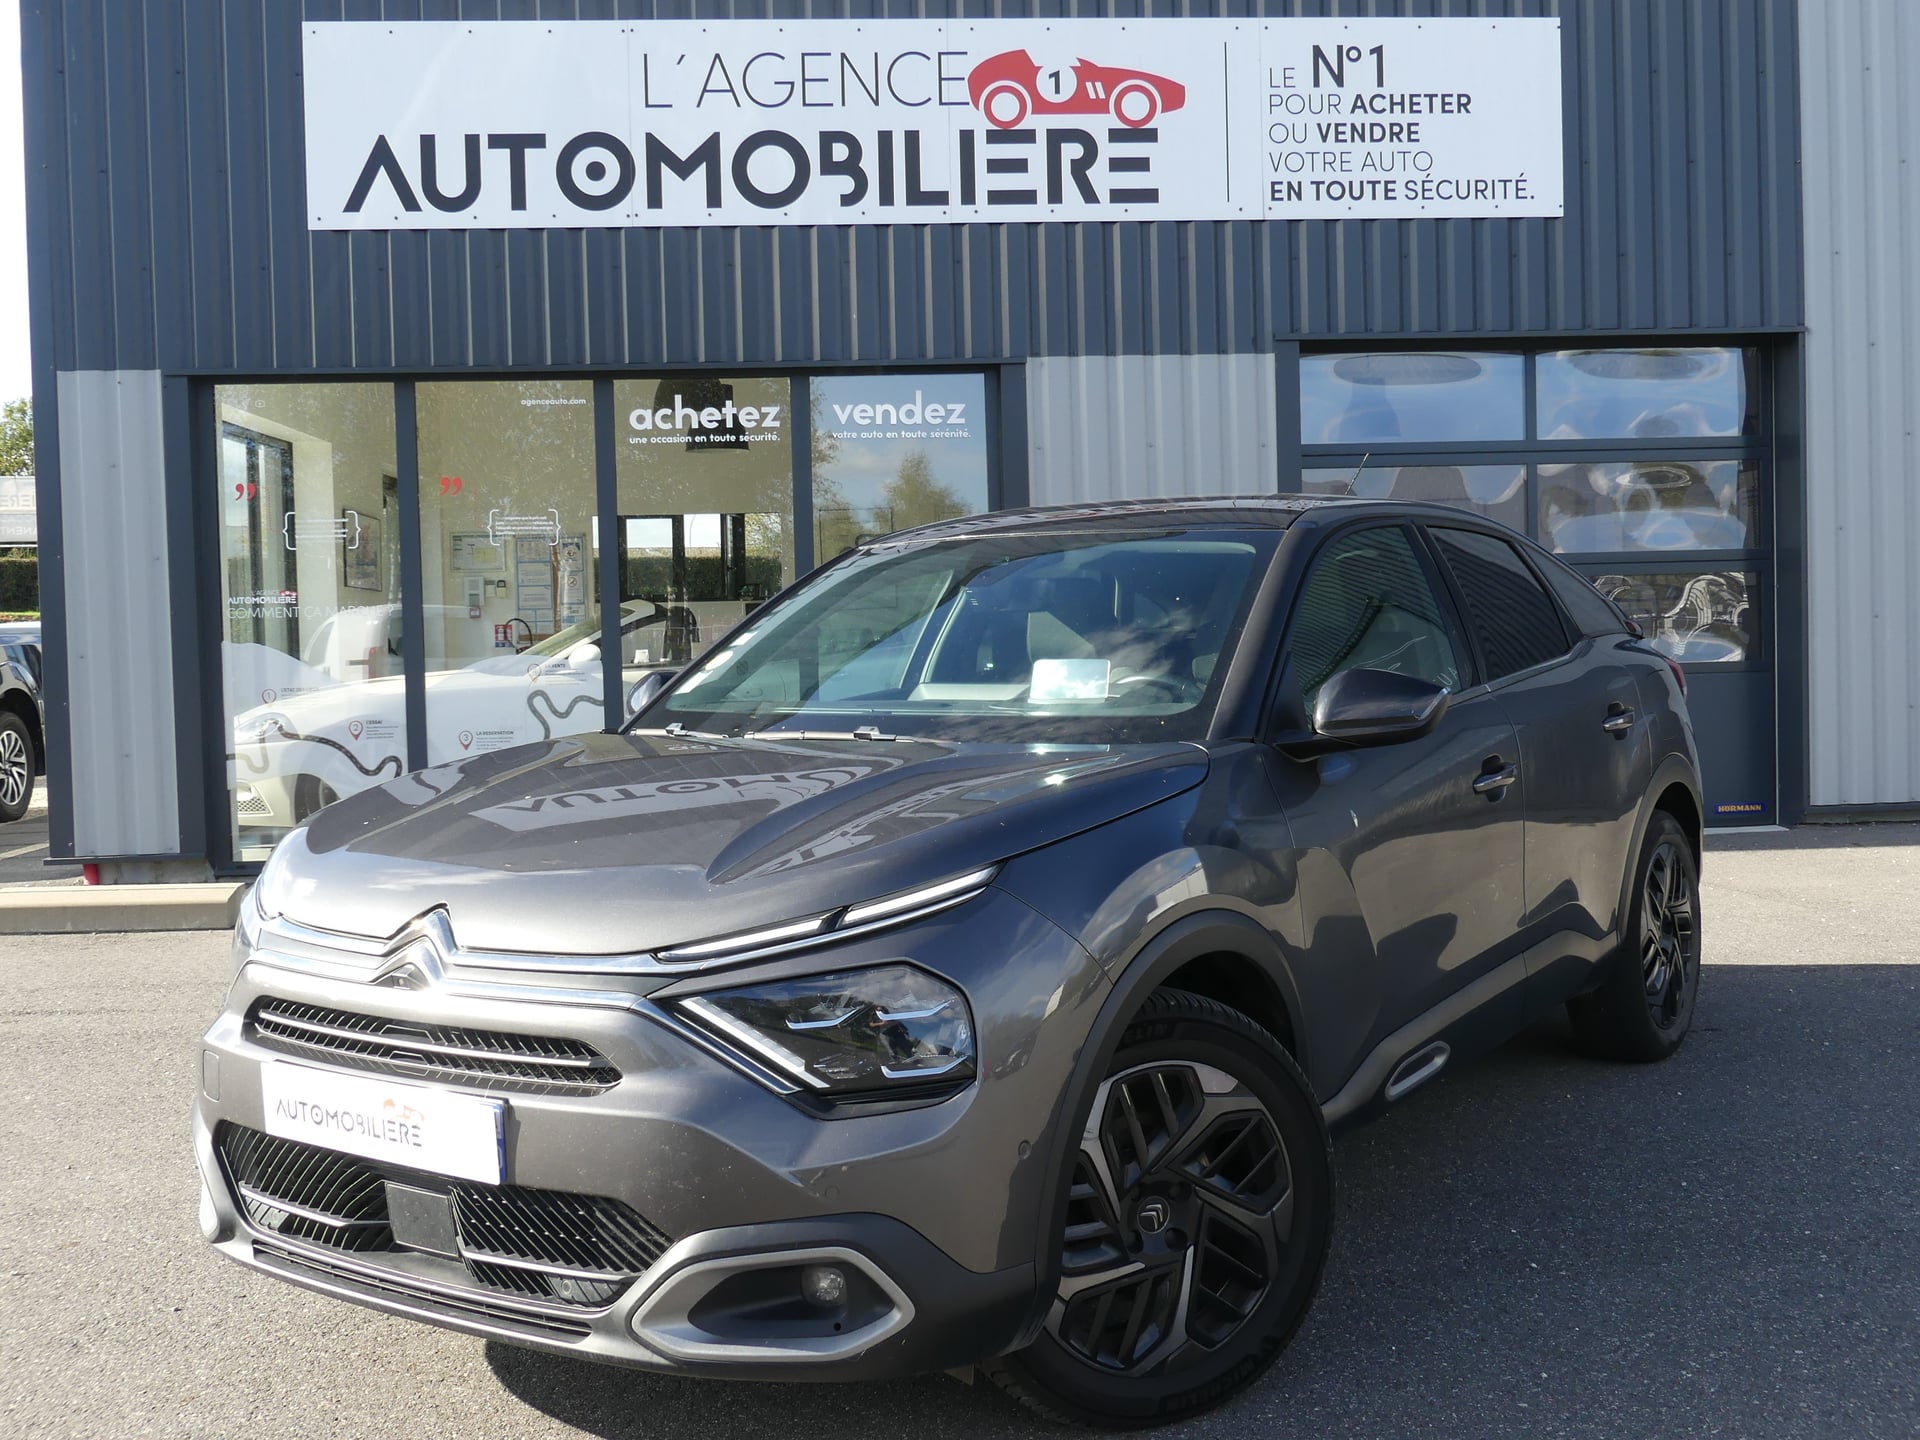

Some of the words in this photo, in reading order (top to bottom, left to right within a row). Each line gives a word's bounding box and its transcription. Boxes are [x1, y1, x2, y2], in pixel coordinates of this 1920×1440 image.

[643, 51, 969, 109] L'AGENCE
[1269, 67, 1297, 88] LE
[1269, 93, 1342, 115] POUR
[1350, 93, 1472, 115] ACHETER
[1269, 122, 1308, 144] OU
[1317, 122, 1421, 144] VENDRE
[343, 128, 1160, 213] AUTOMOBILIERE
[1269, 151, 1353, 173] VOTRE
[1361, 151, 1434, 173] AUTO
[1270, 181, 1303, 202] EN
[1310, 180, 1397, 201] TOUTE
[1404, 173, 1536, 201] SÉCURITÉ.
[520, 398, 586, 407] agenceauto.com
[629, 394, 781, 431] achetez
[832, 390, 966, 425] vendez
[629, 436, 648, 444] une
[650, 433, 692, 443] occasion
[694, 434, 707, 443] en
[709, 433, 737, 443] toute
[739, 431, 781, 442] sécurité.
[832, 430, 858, 439] votre
[861, 430, 884, 439] auto
[886, 431, 898, 439] en
[901, 430, 928, 439] toute
[929, 428, 972, 439] sérénité.
[228, 606, 300, 619] COMMENT
[276, 1098, 422, 1147] AUTOMOBILIERE
